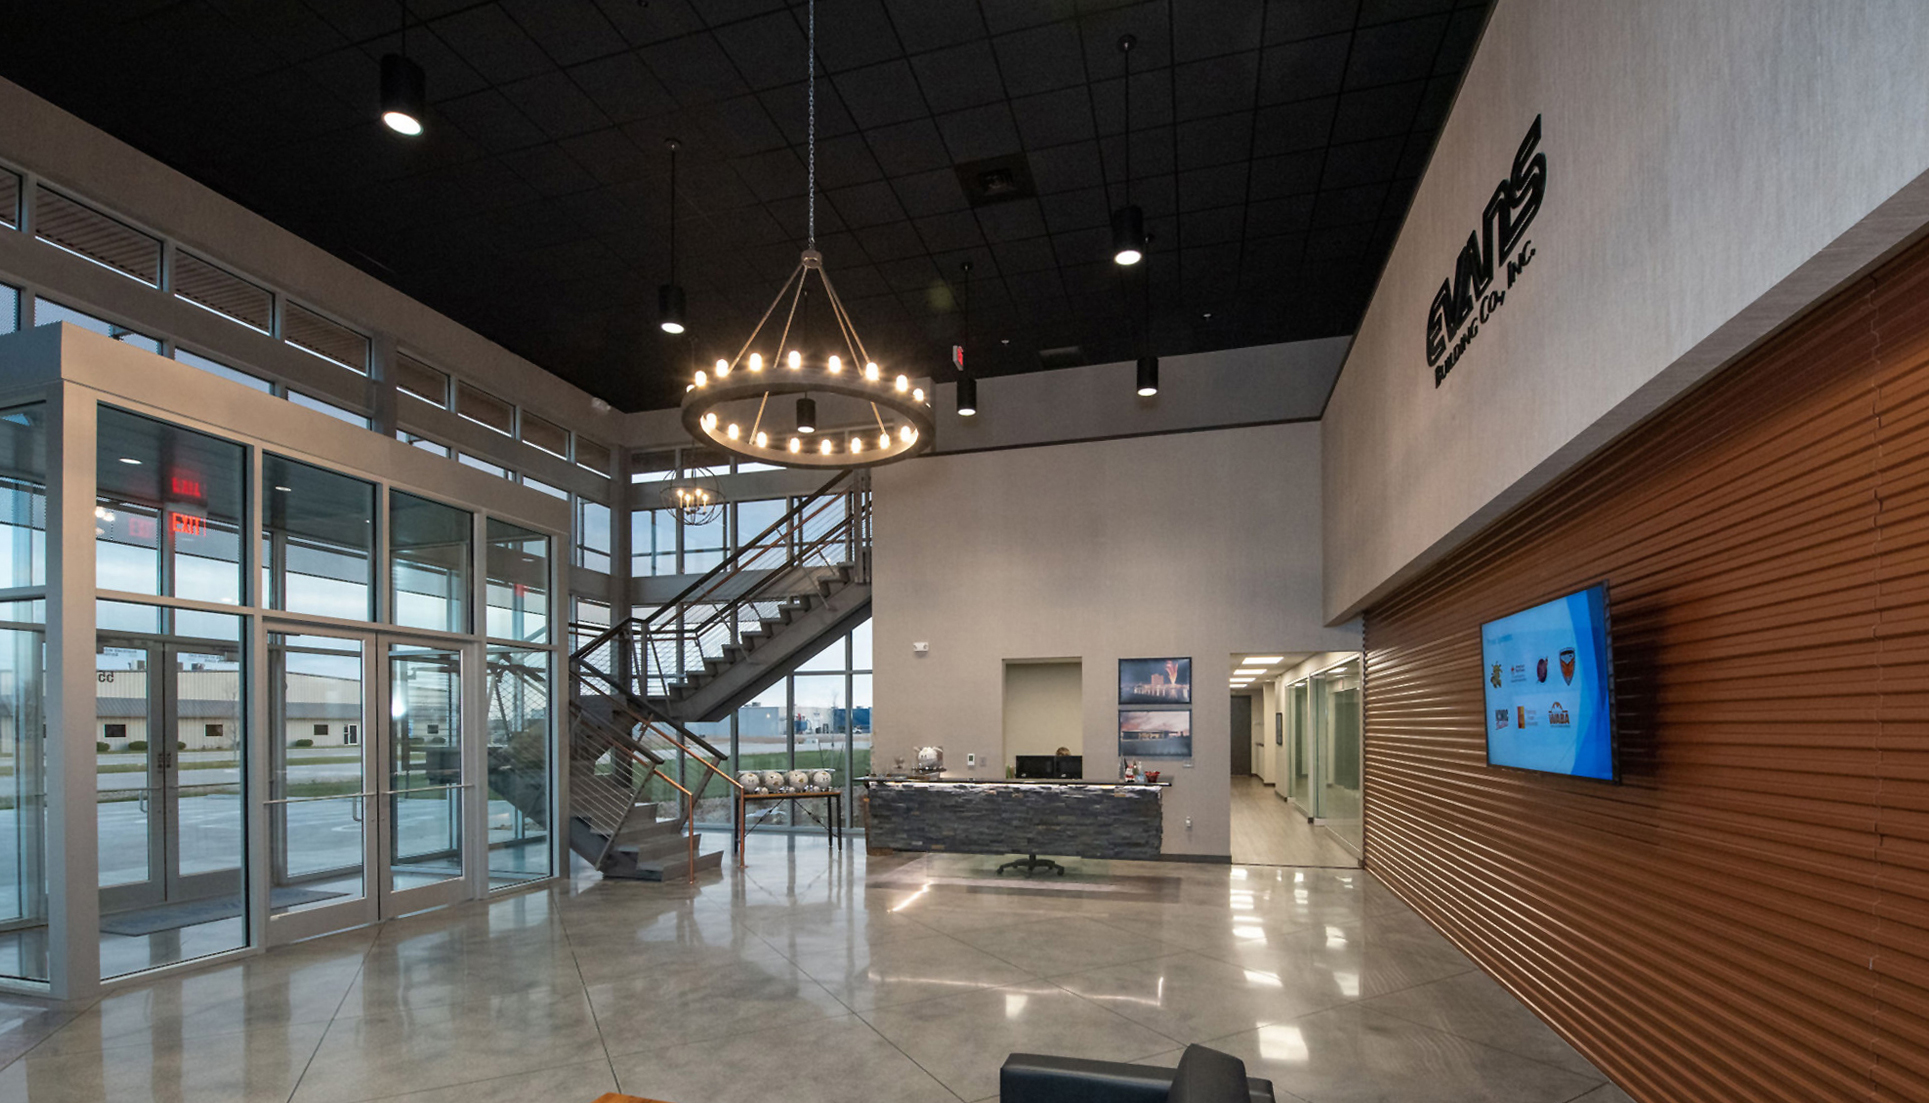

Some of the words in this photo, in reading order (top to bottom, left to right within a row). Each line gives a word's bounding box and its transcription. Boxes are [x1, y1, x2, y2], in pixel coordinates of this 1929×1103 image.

[1426, 113, 1547, 367] EVANS
[1507, 240, 1536, 289] INC.
[172, 512, 201, 536] EXIT
